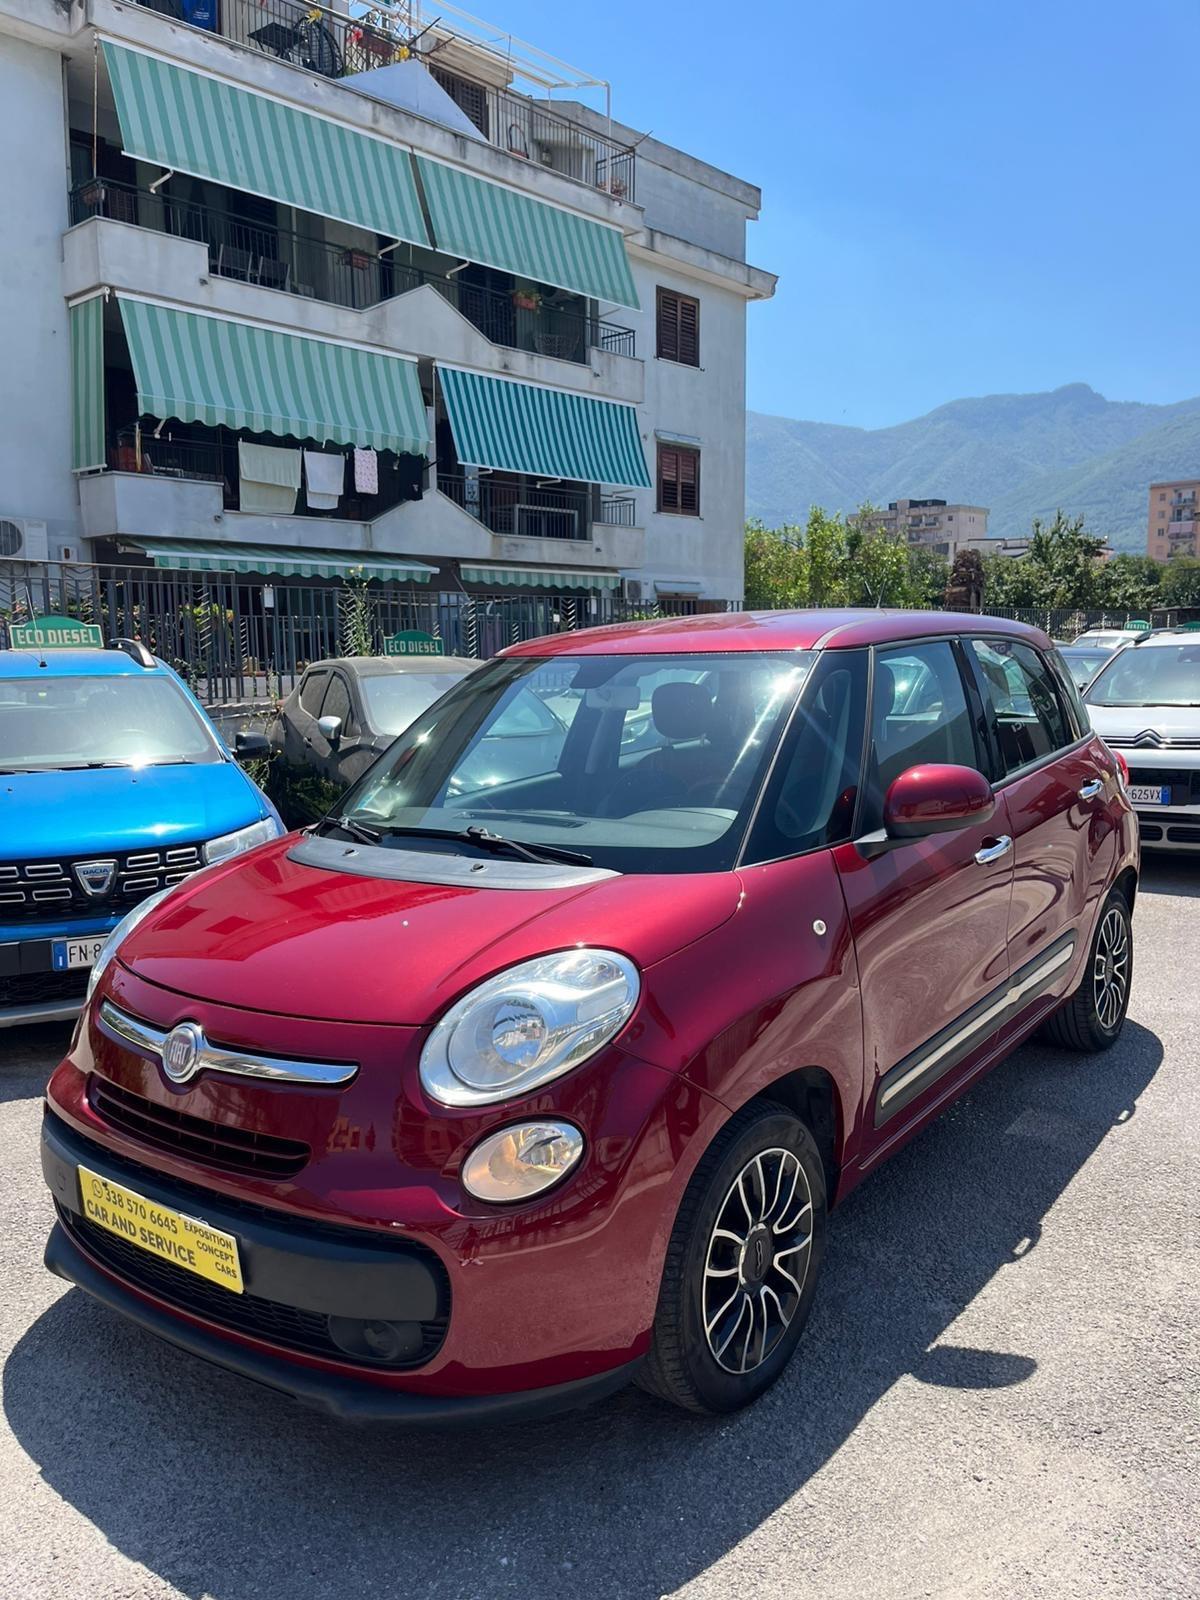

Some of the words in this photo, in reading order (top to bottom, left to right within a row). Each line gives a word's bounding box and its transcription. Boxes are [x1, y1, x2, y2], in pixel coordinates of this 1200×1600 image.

[16, 629, 44, 644] ECO
[47, 628, 97, 644] DIESEL
[388, 641, 406, 653] ECO
[408, 641, 440, 653] DIESEL
[169, 1039, 190, 1065] FIAT
[105, 1187, 124, 1209] 338
[127, 1198, 147, 1220] 570
[150, 1210, 178, 1234] 6645
[87, 1199, 110, 1224] CAR
[112, 1212, 137, 1236] AND
[140, 1226, 196, 1266] SERVICE
[183, 1221, 233, 1251] EXPOSITION
[196, 1239, 234, 1264] CONCEPT
[215, 1262, 238, 1278] CARS
